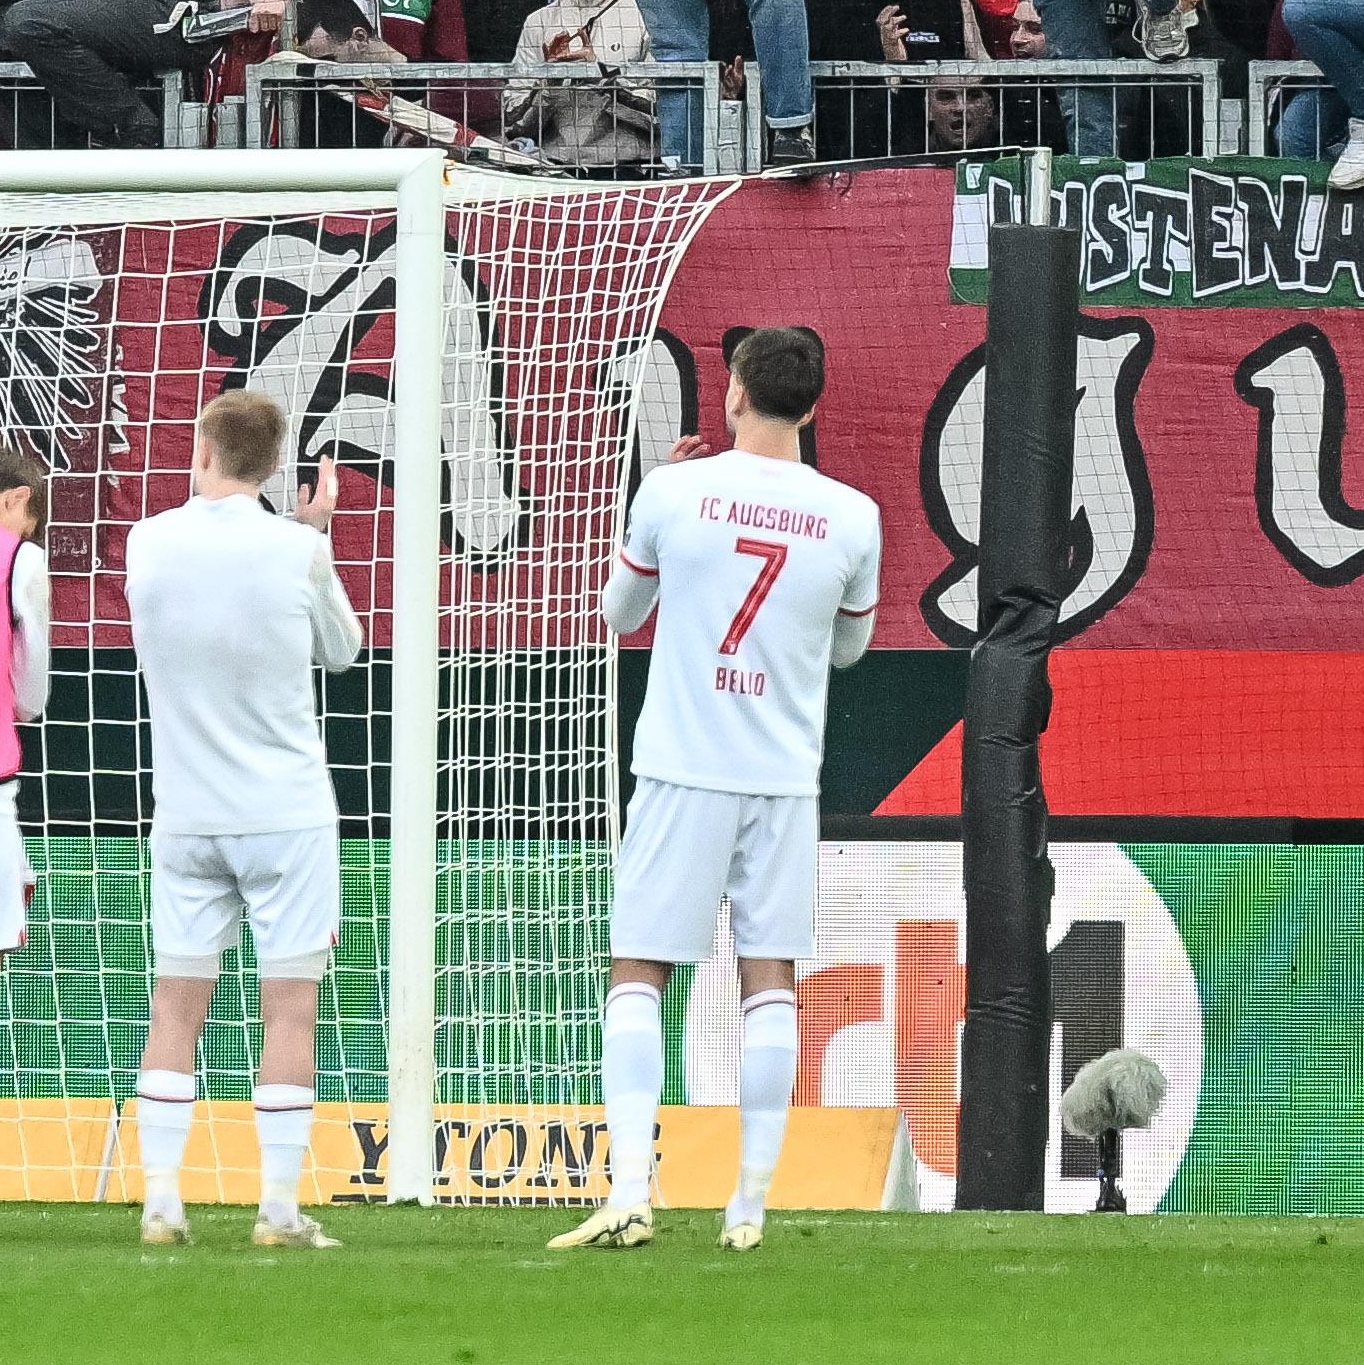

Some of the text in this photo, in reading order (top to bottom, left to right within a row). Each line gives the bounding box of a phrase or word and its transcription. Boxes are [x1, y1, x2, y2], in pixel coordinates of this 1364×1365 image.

[988, 169, 1364, 297] STENA
[699, 497, 829, 541] FC AUGSBURG
[718, 537, 789, 656] 7
